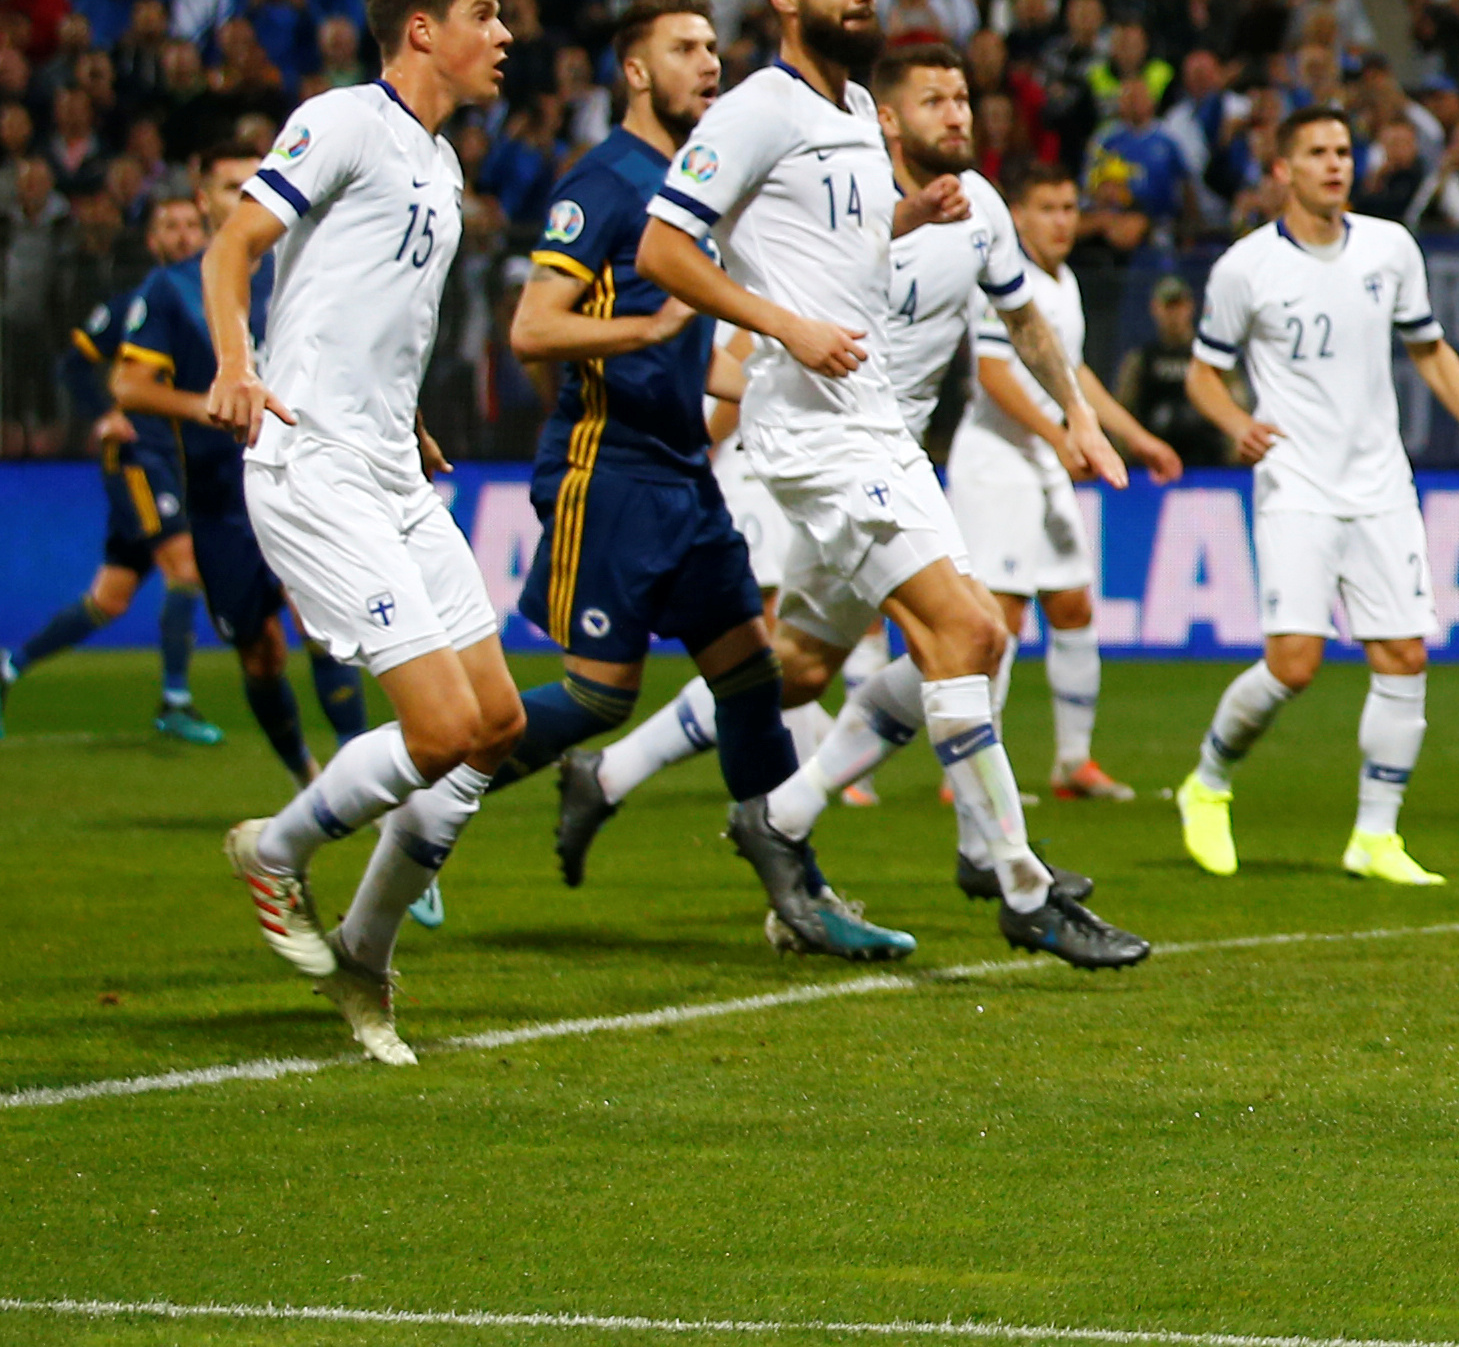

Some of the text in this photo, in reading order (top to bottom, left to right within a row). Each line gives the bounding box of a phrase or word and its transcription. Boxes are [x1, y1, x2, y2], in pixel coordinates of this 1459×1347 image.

[821, 172, 864, 231] 14
[395, 202, 438, 269] 15
[1286, 313, 1335, 360] 22
